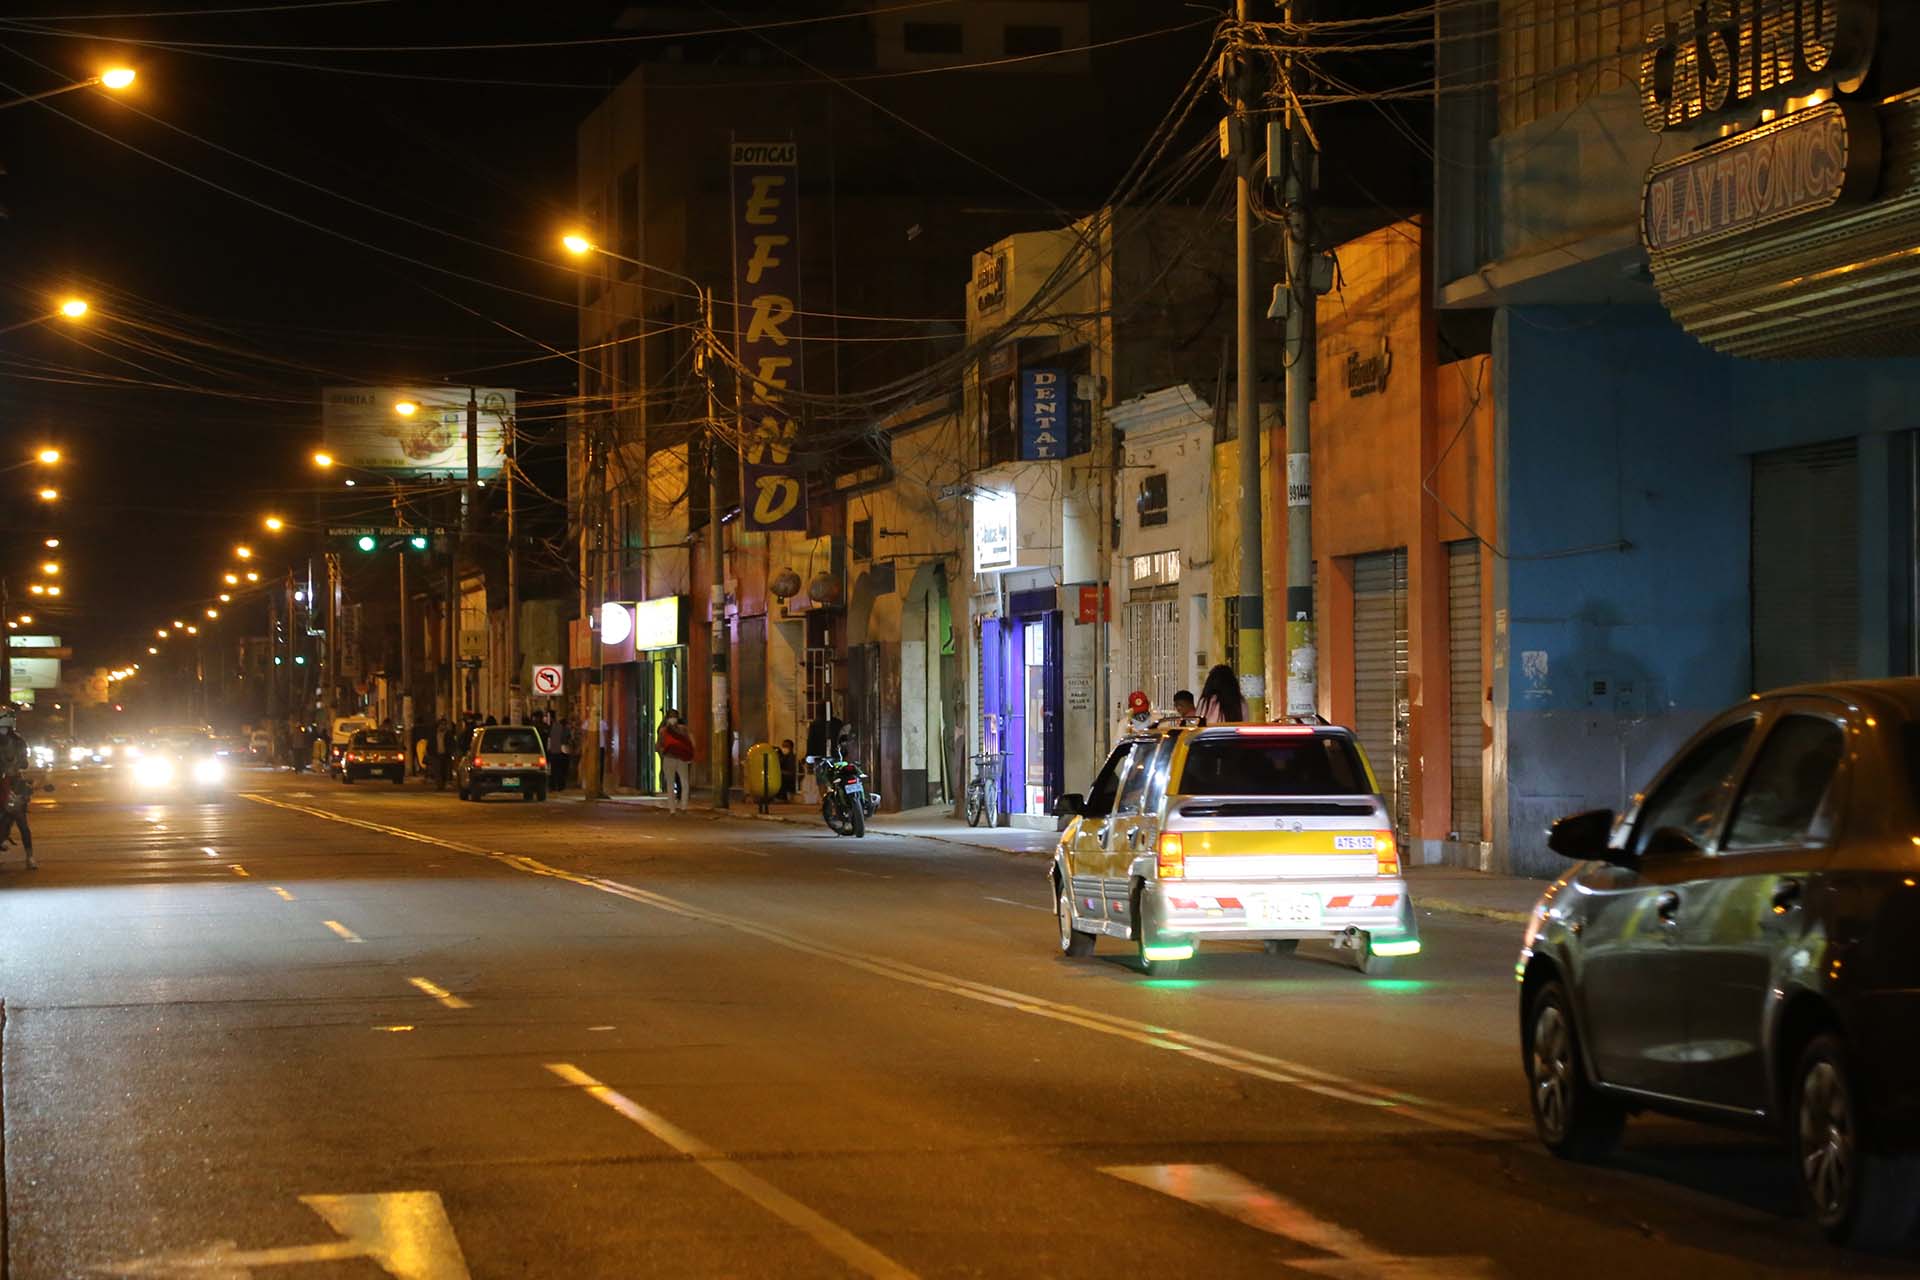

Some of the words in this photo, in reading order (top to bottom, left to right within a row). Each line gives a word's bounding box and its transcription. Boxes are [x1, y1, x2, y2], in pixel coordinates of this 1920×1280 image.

[1640, 0, 1839, 133] CASINO
[735, 146, 795, 163] BOTICAS
[1652, 121, 1841, 247] PLAYTRONICS
[744, 175, 800, 524] EFREND
[1033, 372, 1058, 458] DENTAL
[1337, 837, 1373, 848] ATE-152
